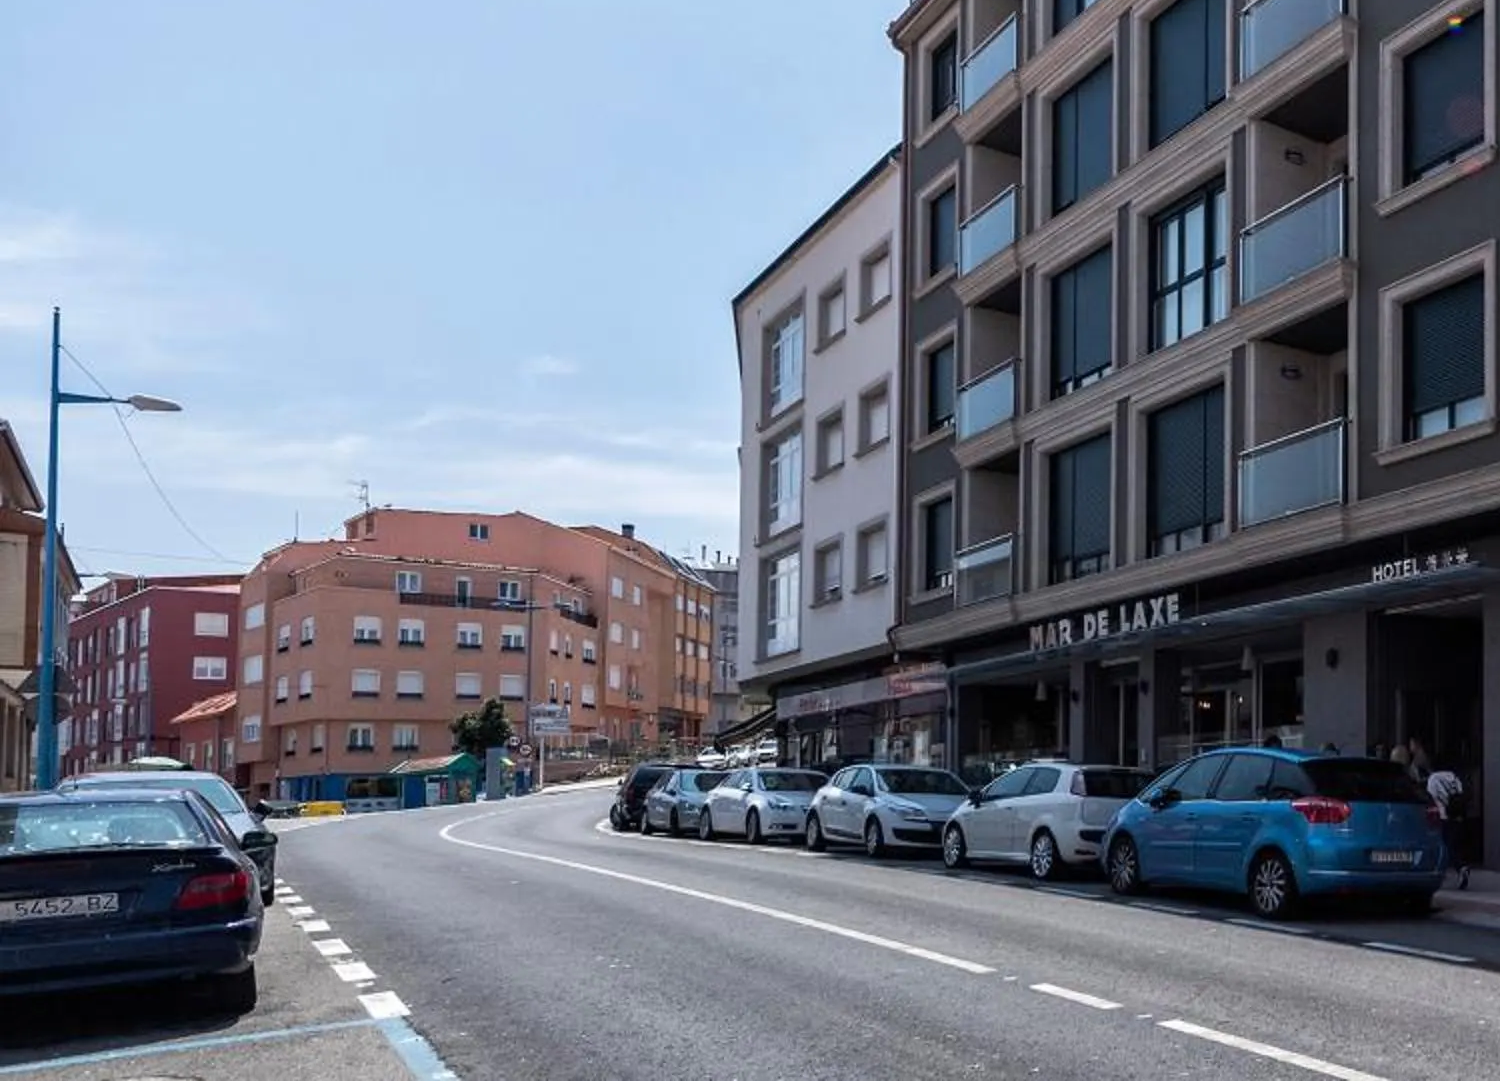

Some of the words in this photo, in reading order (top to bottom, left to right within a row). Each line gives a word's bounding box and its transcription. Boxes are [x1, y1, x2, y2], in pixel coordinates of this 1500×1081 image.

[1372, 558, 1420, 583] HOTEL
[1029, 619, 1072, 651] MAR
[1084, 609, 1109, 639] DE
[1119, 593, 1179, 632] LAXE
[15, 899, 73, 917] 5452
[87, 895, 118, 911] BZ
